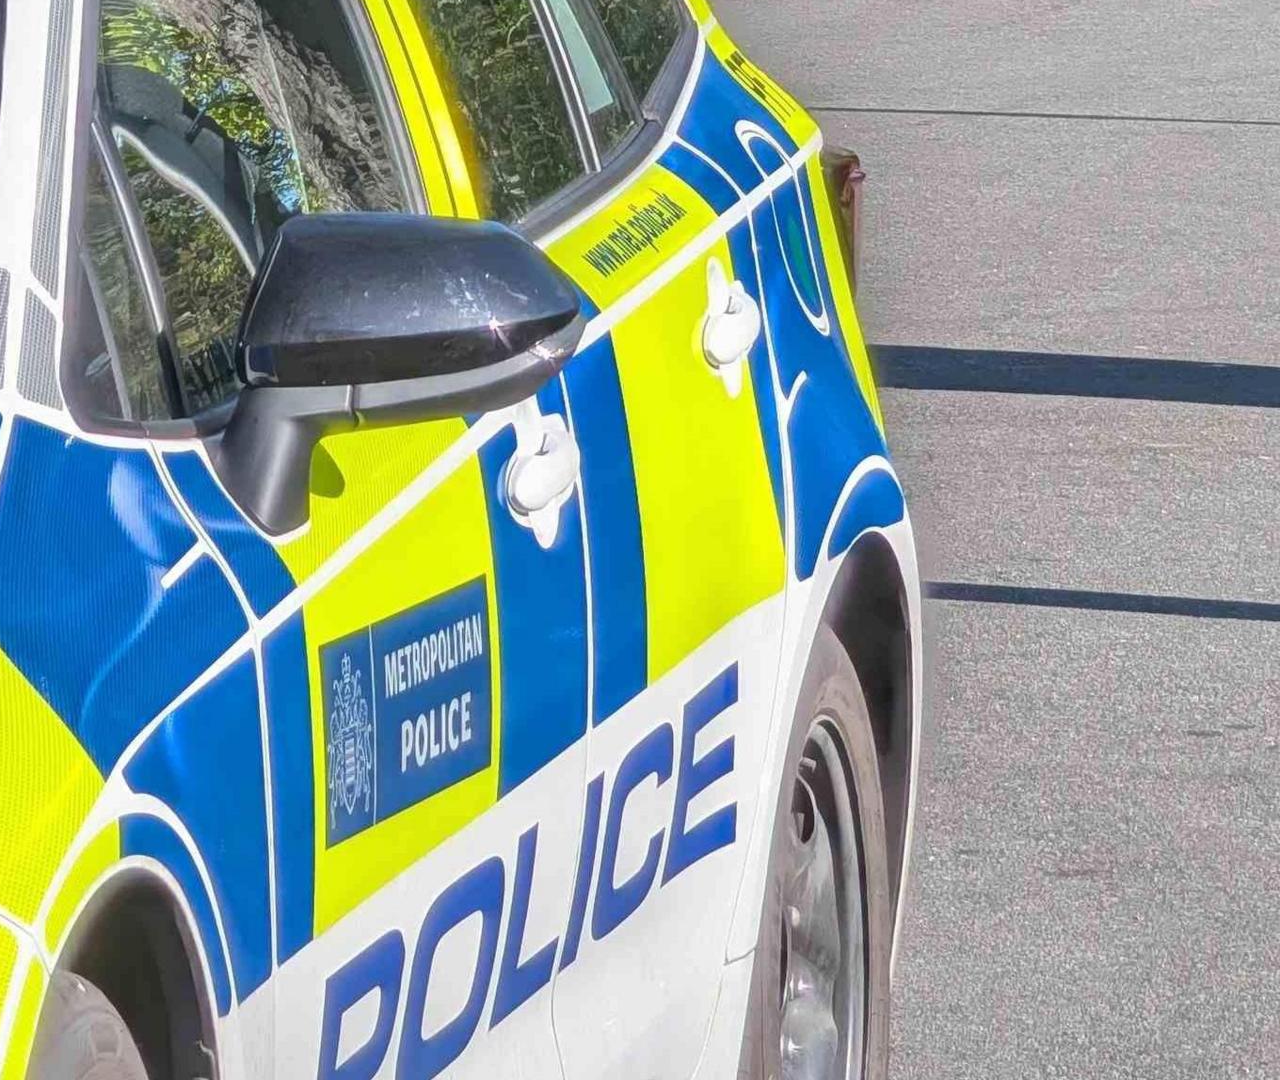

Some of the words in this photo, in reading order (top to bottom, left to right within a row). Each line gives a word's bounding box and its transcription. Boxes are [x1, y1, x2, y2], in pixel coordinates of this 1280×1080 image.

[581, 187, 687, 277] www.met.police.uk
[384, 613, 483, 698] METROPOLITAN
[401, 691, 472, 774] POLICE
[317, 660, 738, 1080] POLICE
